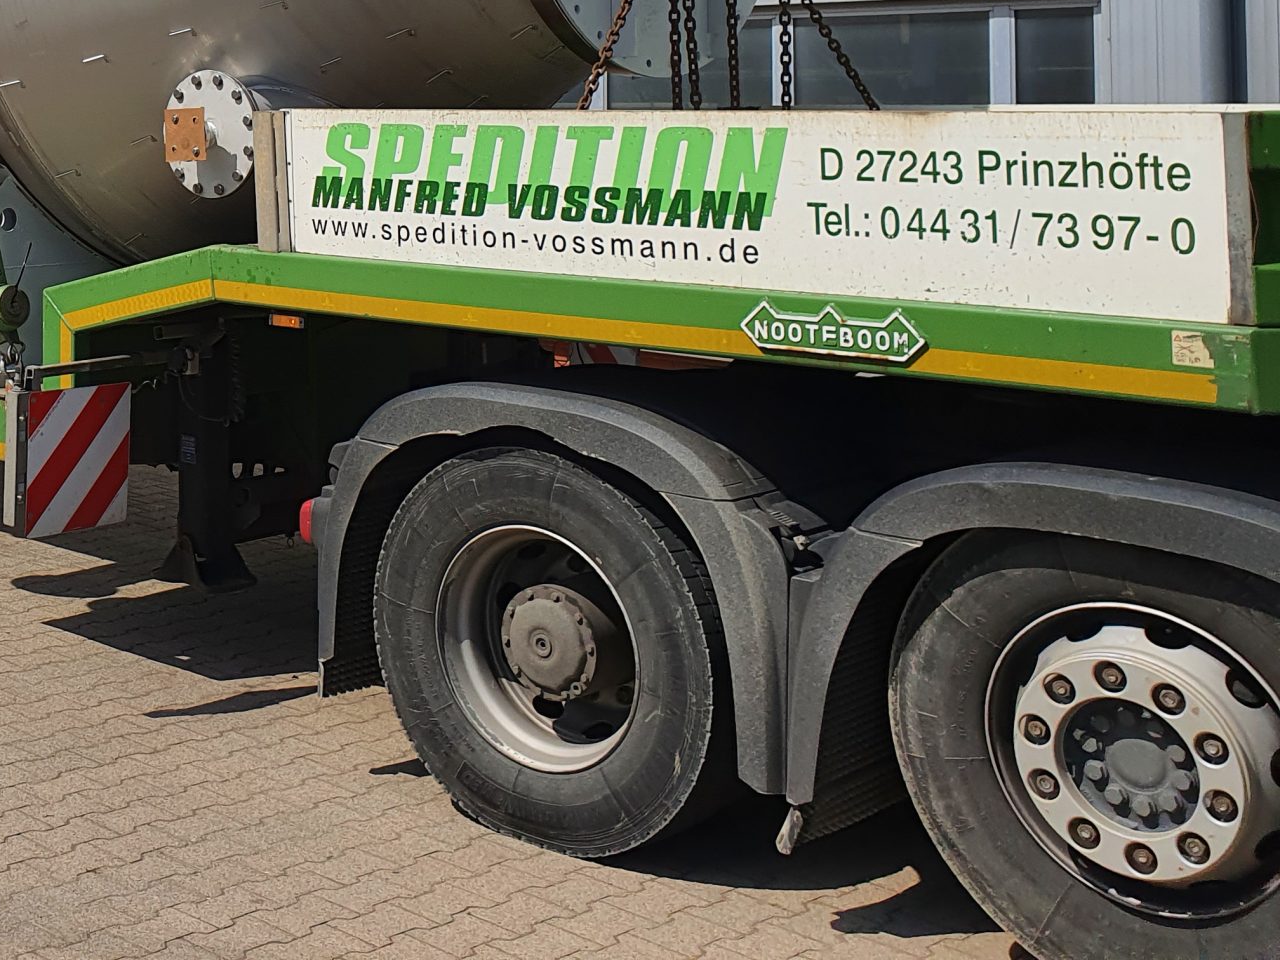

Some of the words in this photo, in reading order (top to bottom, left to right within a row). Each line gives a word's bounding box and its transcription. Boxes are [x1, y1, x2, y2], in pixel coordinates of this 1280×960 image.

[322, 122, 789, 217] SPEDITION
[820, 147, 843, 181] D
[856, 149, 964, 185] 27243
[978, 150, 1192, 192] Prinzhöfte
[311, 175, 489, 217] MANFRED
[507, 183, 768, 232] VOSSMANN
[806, 201, 870, 238] Tel.:
[311, 218, 760, 265] www.spedition-vossmann.de
[754, 319, 909, 354] NOOTEBOOM
